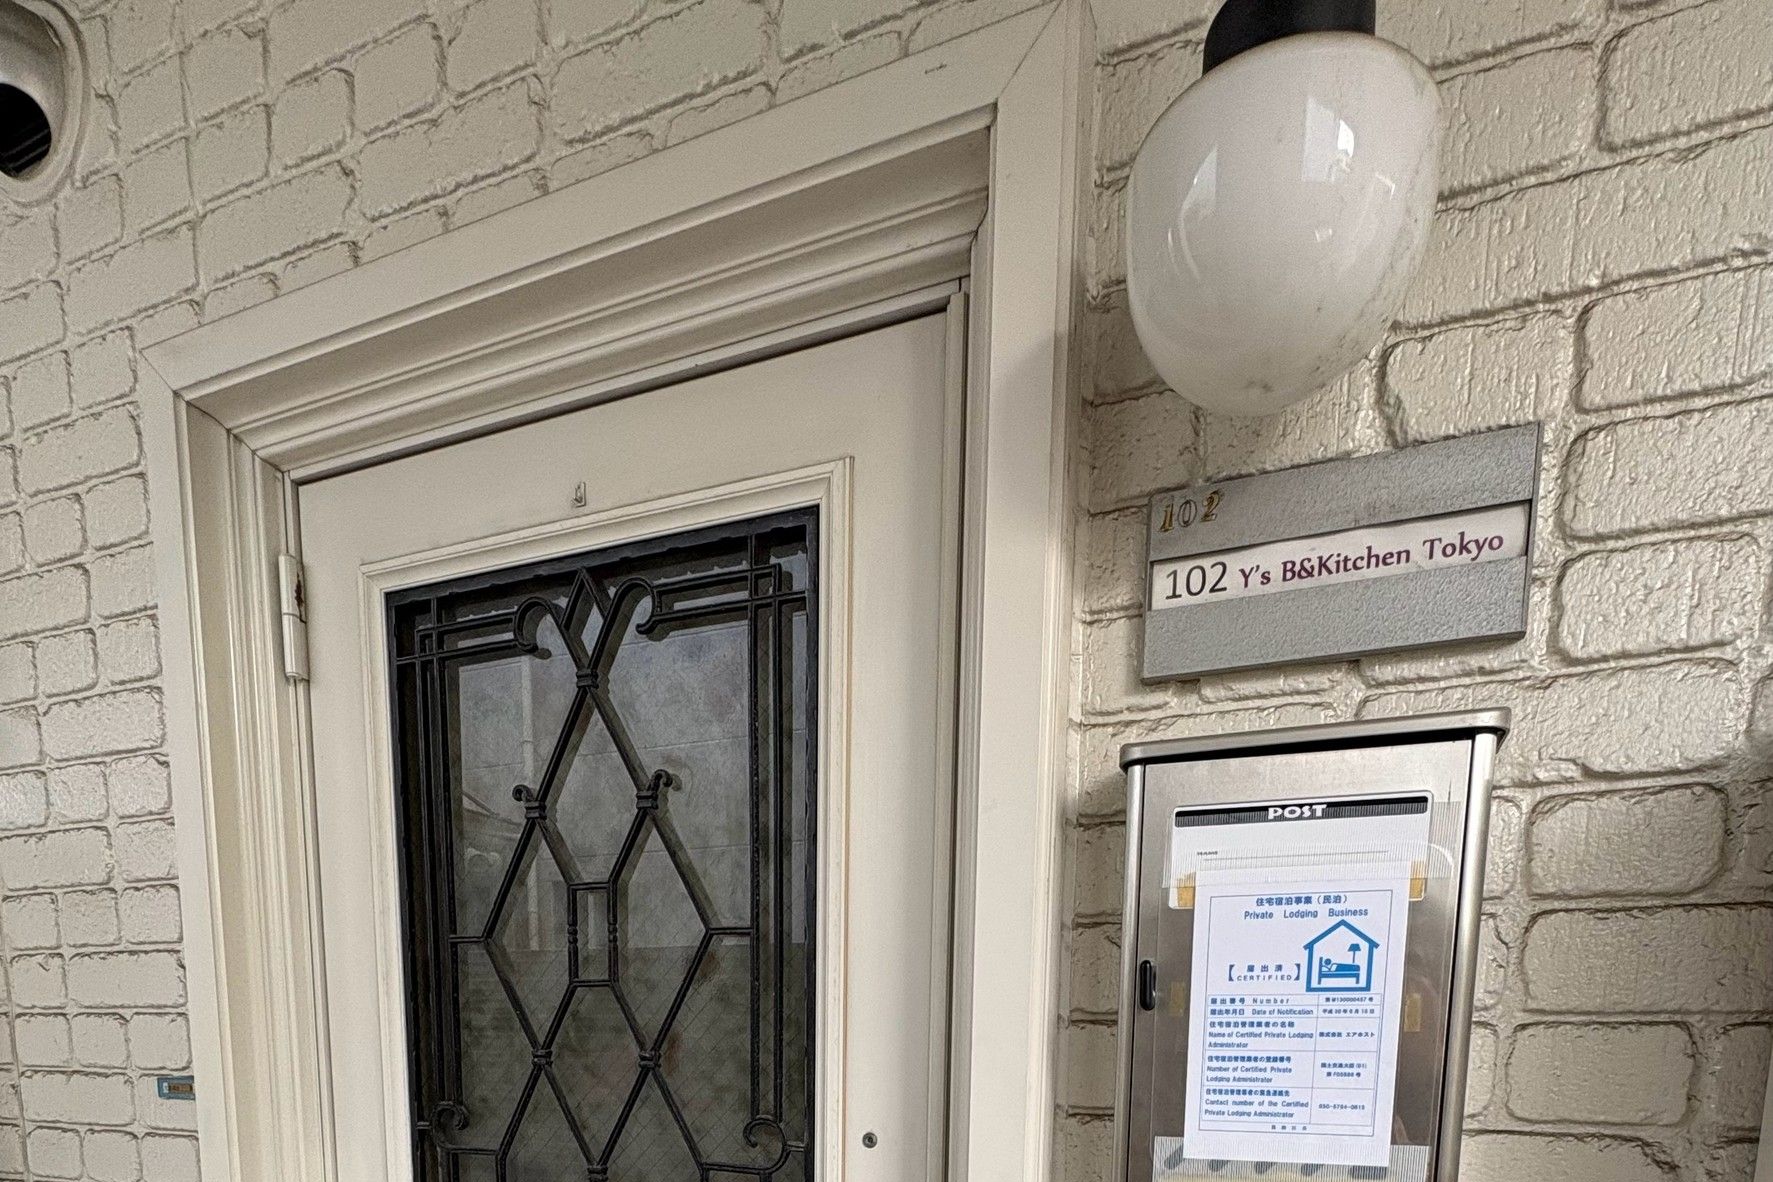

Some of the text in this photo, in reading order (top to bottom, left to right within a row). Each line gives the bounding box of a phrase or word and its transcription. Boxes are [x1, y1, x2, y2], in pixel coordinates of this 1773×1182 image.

[1159, 490, 1223, 533] 102
[1165, 532, 1504, 600] 102 Y's B&Kitchen Tokyo
[1267, 804, 1327, 820] POST
[1244, 908, 1368, 920] Private Lodging Business
[1206, 1076, 1231, 1084] Lodging
[1227, 1110, 1251, 1118] Lodging
